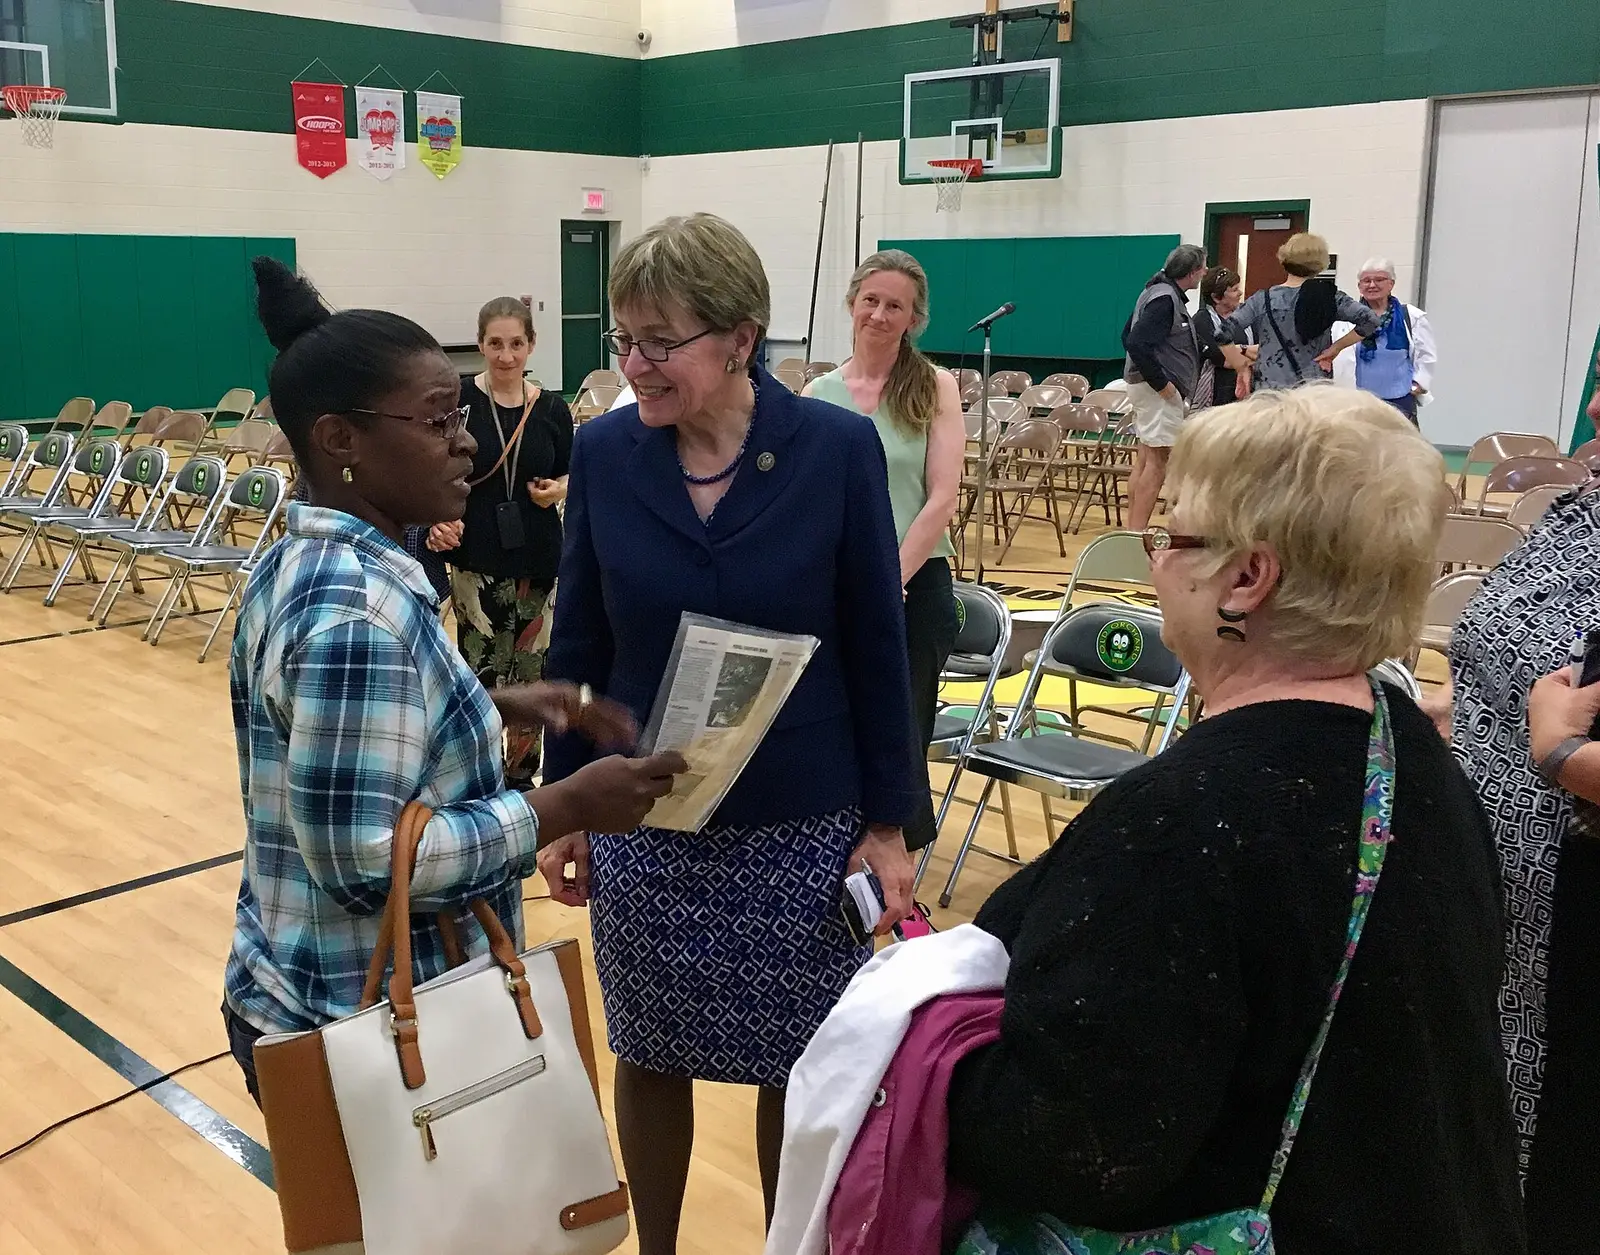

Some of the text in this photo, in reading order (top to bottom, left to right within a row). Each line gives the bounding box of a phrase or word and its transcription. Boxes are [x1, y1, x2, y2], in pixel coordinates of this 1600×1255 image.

[306, 120, 337, 130] HOOPS
[308, 160, 336, 168] 2012-2013
[1099, 622, 1141, 661] OLD ORCHARD
